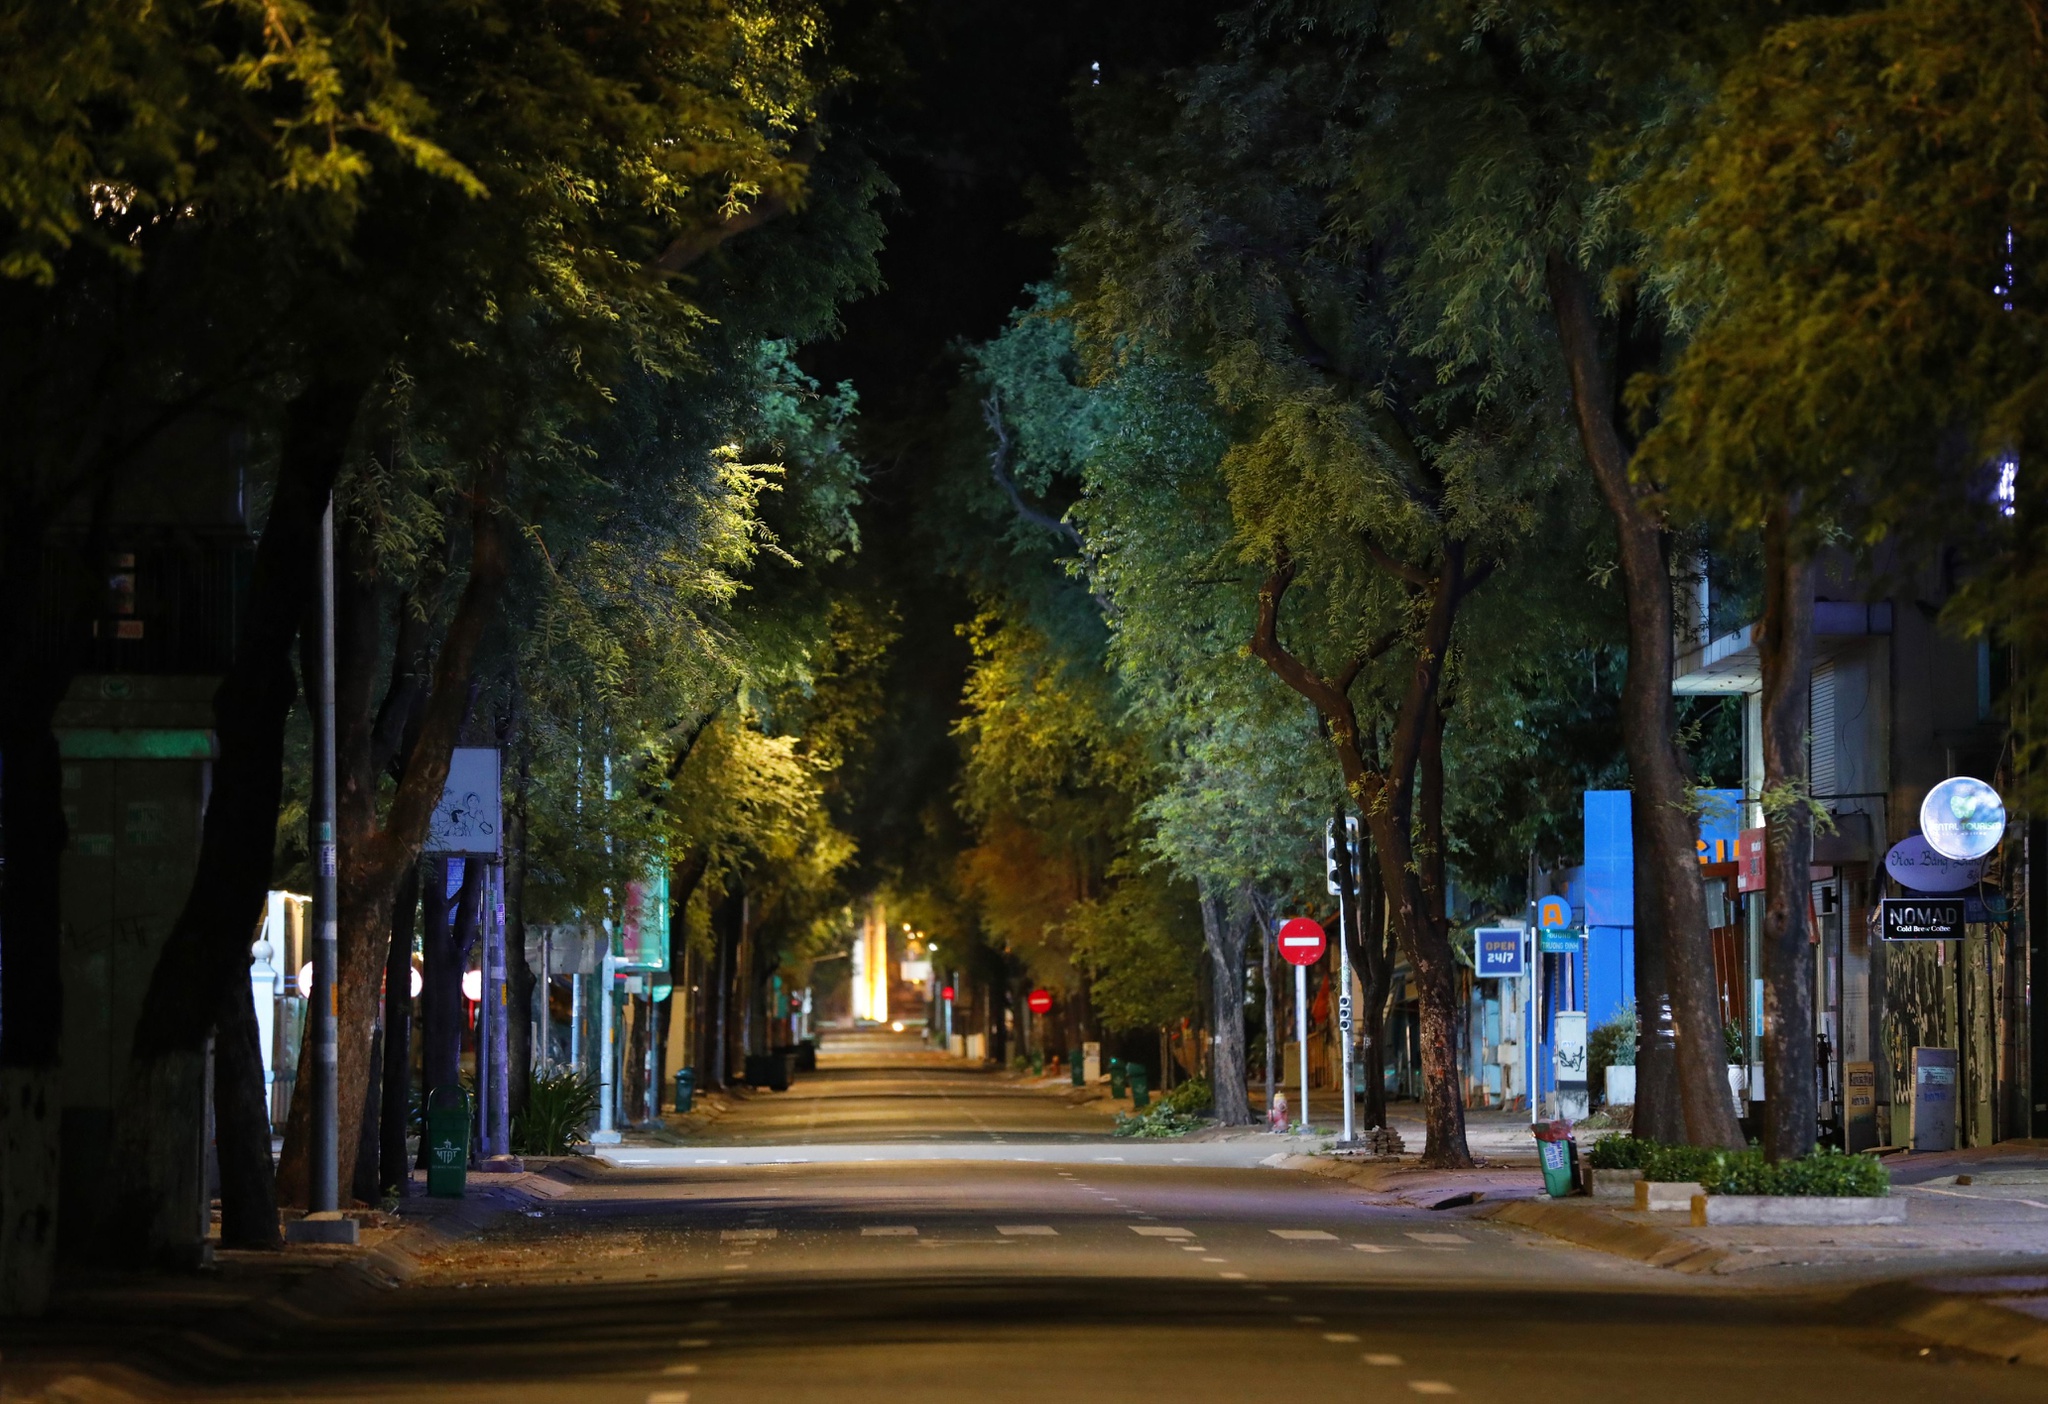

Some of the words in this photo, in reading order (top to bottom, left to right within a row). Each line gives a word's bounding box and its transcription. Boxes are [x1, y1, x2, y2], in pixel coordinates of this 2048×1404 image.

[1960, 822, 2002, 831] TOURISM
[1890, 907, 1957, 925] NOMAD
[1485, 942, 1515, 951] OPEN
[1487, 952, 1514, 964] 24/7
